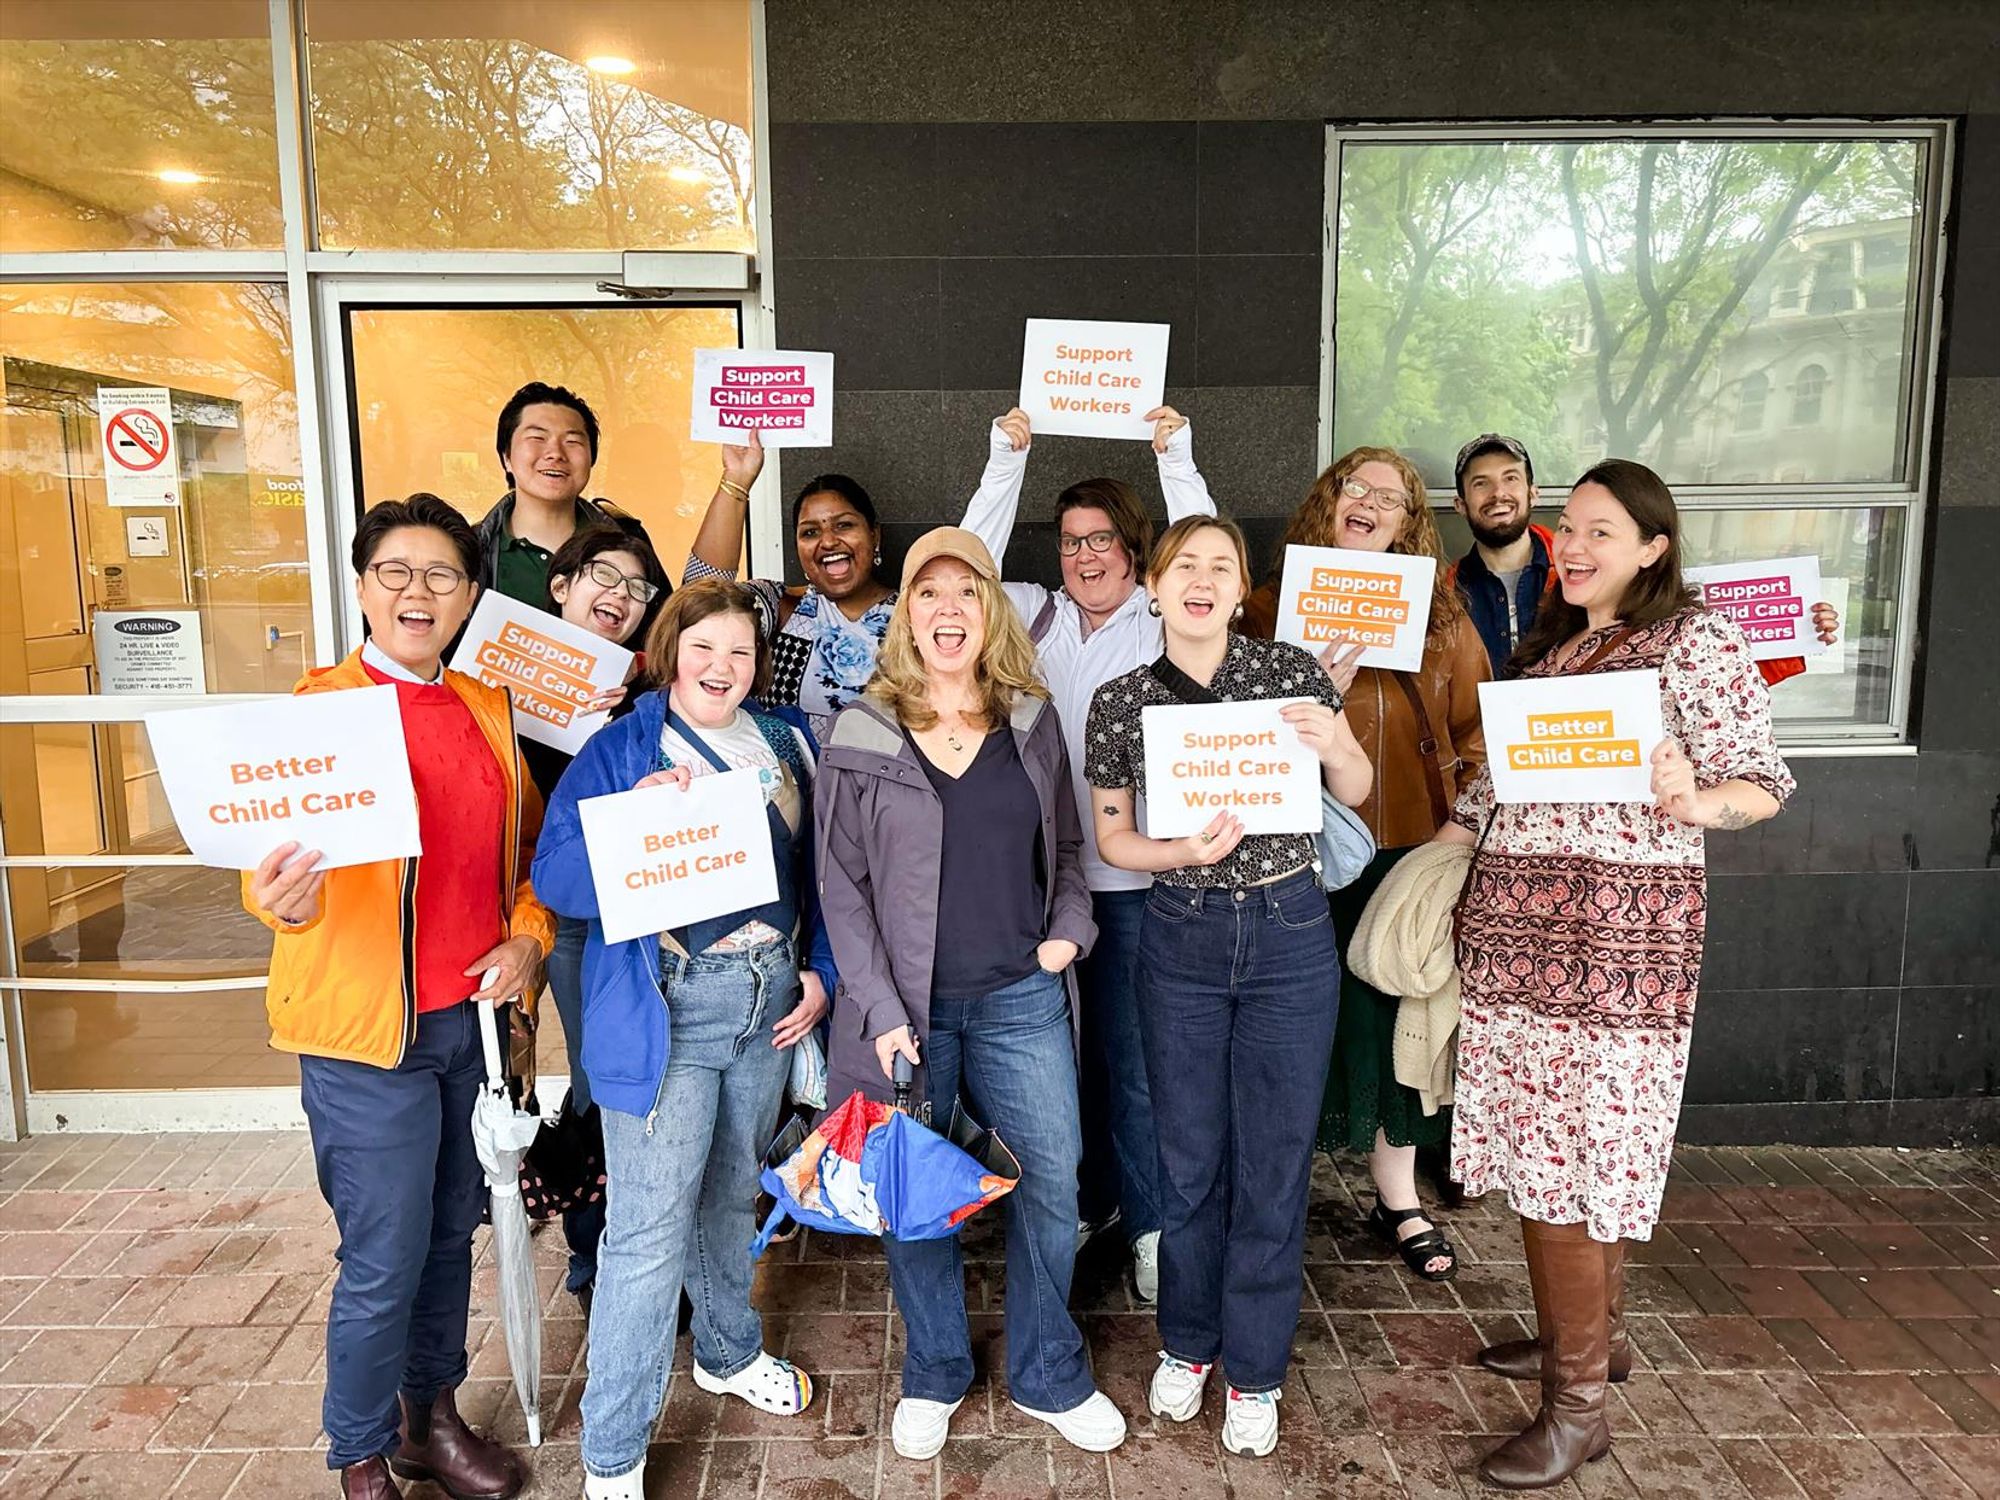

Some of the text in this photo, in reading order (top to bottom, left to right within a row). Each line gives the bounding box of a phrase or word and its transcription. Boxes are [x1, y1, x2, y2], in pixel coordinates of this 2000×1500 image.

[1056, 344, 1133, 364] Support
[726, 369, 801, 386] Support
[1043, 370, 1142, 388] Child Care
[714, 390, 812, 405] Child Care
[1049, 396, 1131, 414] Workers
[722, 412, 803, 427] Workers
[1316, 572, 1397, 593] Support
[1709, 580, 1786, 600] Support
[1302, 597, 1405, 619] Child Care
[1721, 602, 1800, 619] ild Care
[122, 622, 173, 631] WARNING
[1744, 626, 1794, 641] kers
[504, 627, 590, 673] Support
[482, 648, 589, 703] Child Care
[1532, 719, 1608, 737] Better
[1184, 730, 1277, 751] Support
[1513, 746, 1635, 766] Child Care
[230, 754, 337, 785] Better
[1172, 759, 1291, 778] Child Care
[208, 789, 376, 825] Child Care
[1183, 788, 1283, 807] Workers
[643, 824, 719, 853] Better
[624, 850, 747, 890] Child Care
